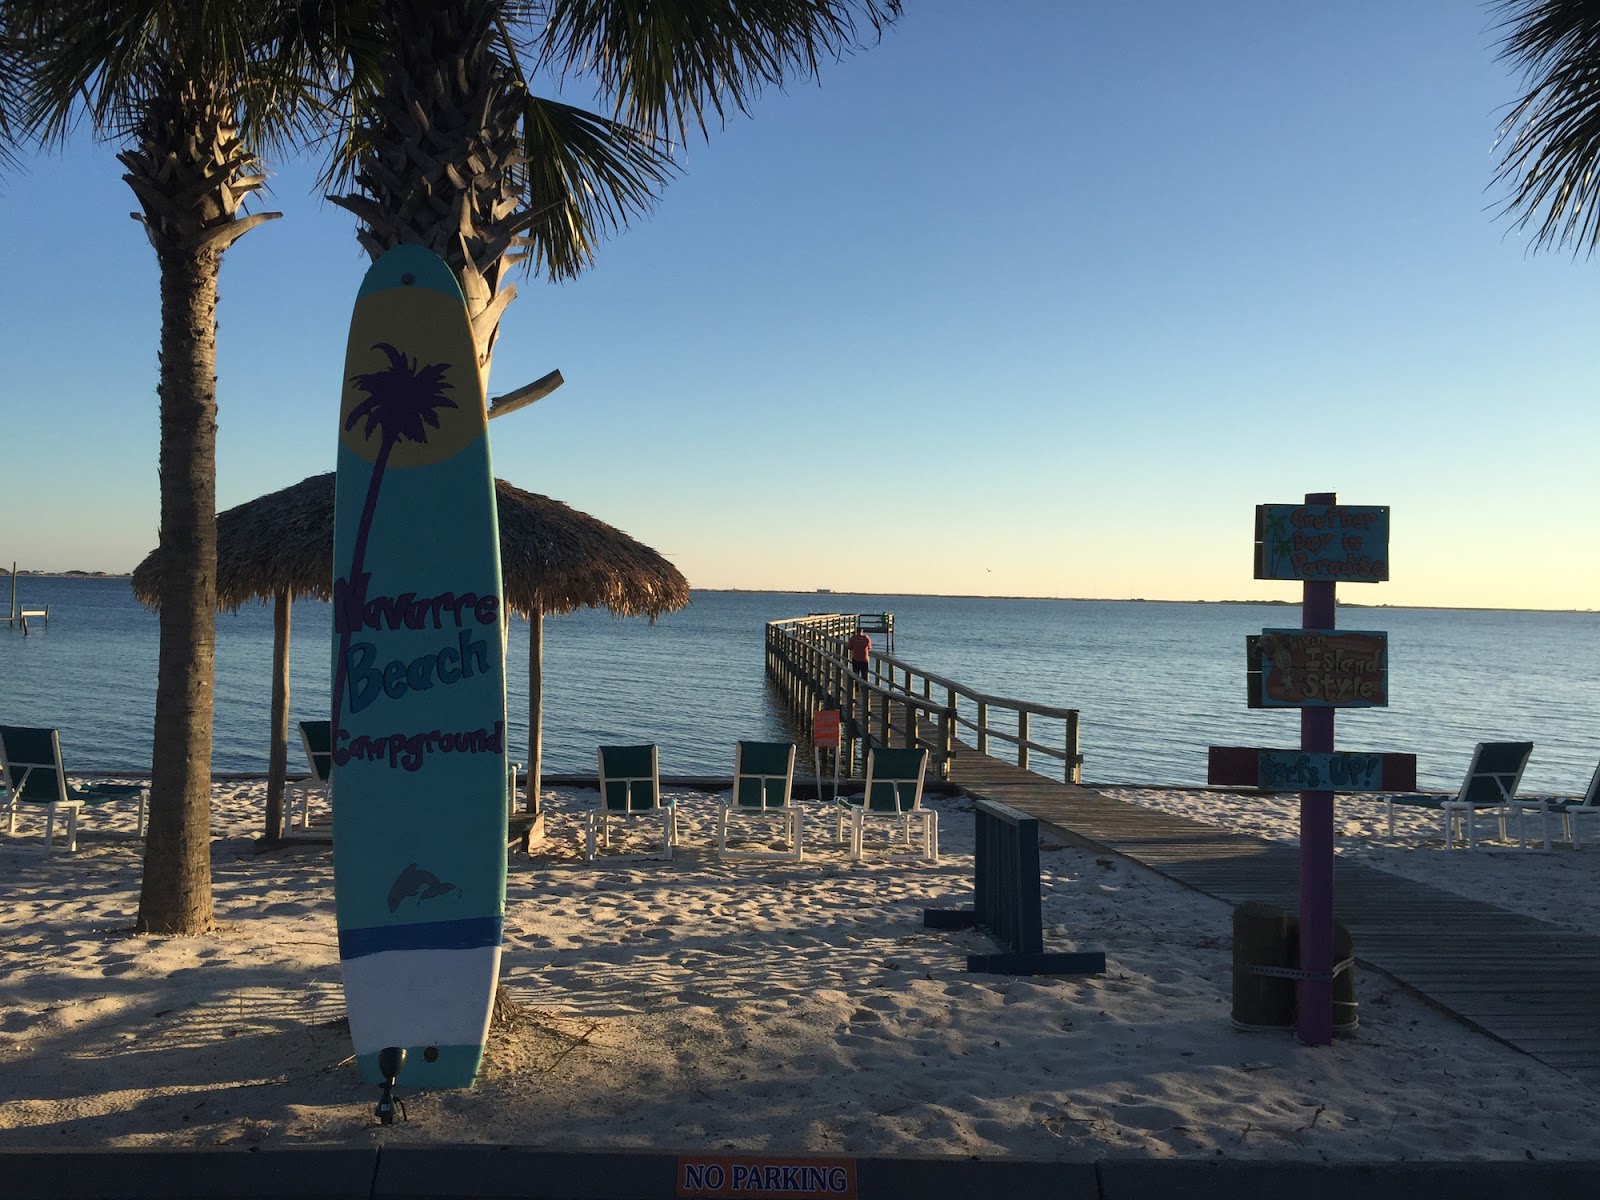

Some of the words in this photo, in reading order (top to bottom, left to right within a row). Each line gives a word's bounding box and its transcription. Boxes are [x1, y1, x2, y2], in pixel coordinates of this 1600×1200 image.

[334, 572, 499, 633] Navarre
[345, 628, 491, 713] Beach
[1305, 647, 1380, 674] Island
[1301, 672, 1374, 701] Style
[332, 720, 504, 772] Campground
[684, 1164, 725, 1190] NO
[731, 1164, 848, 1193] PARKING
